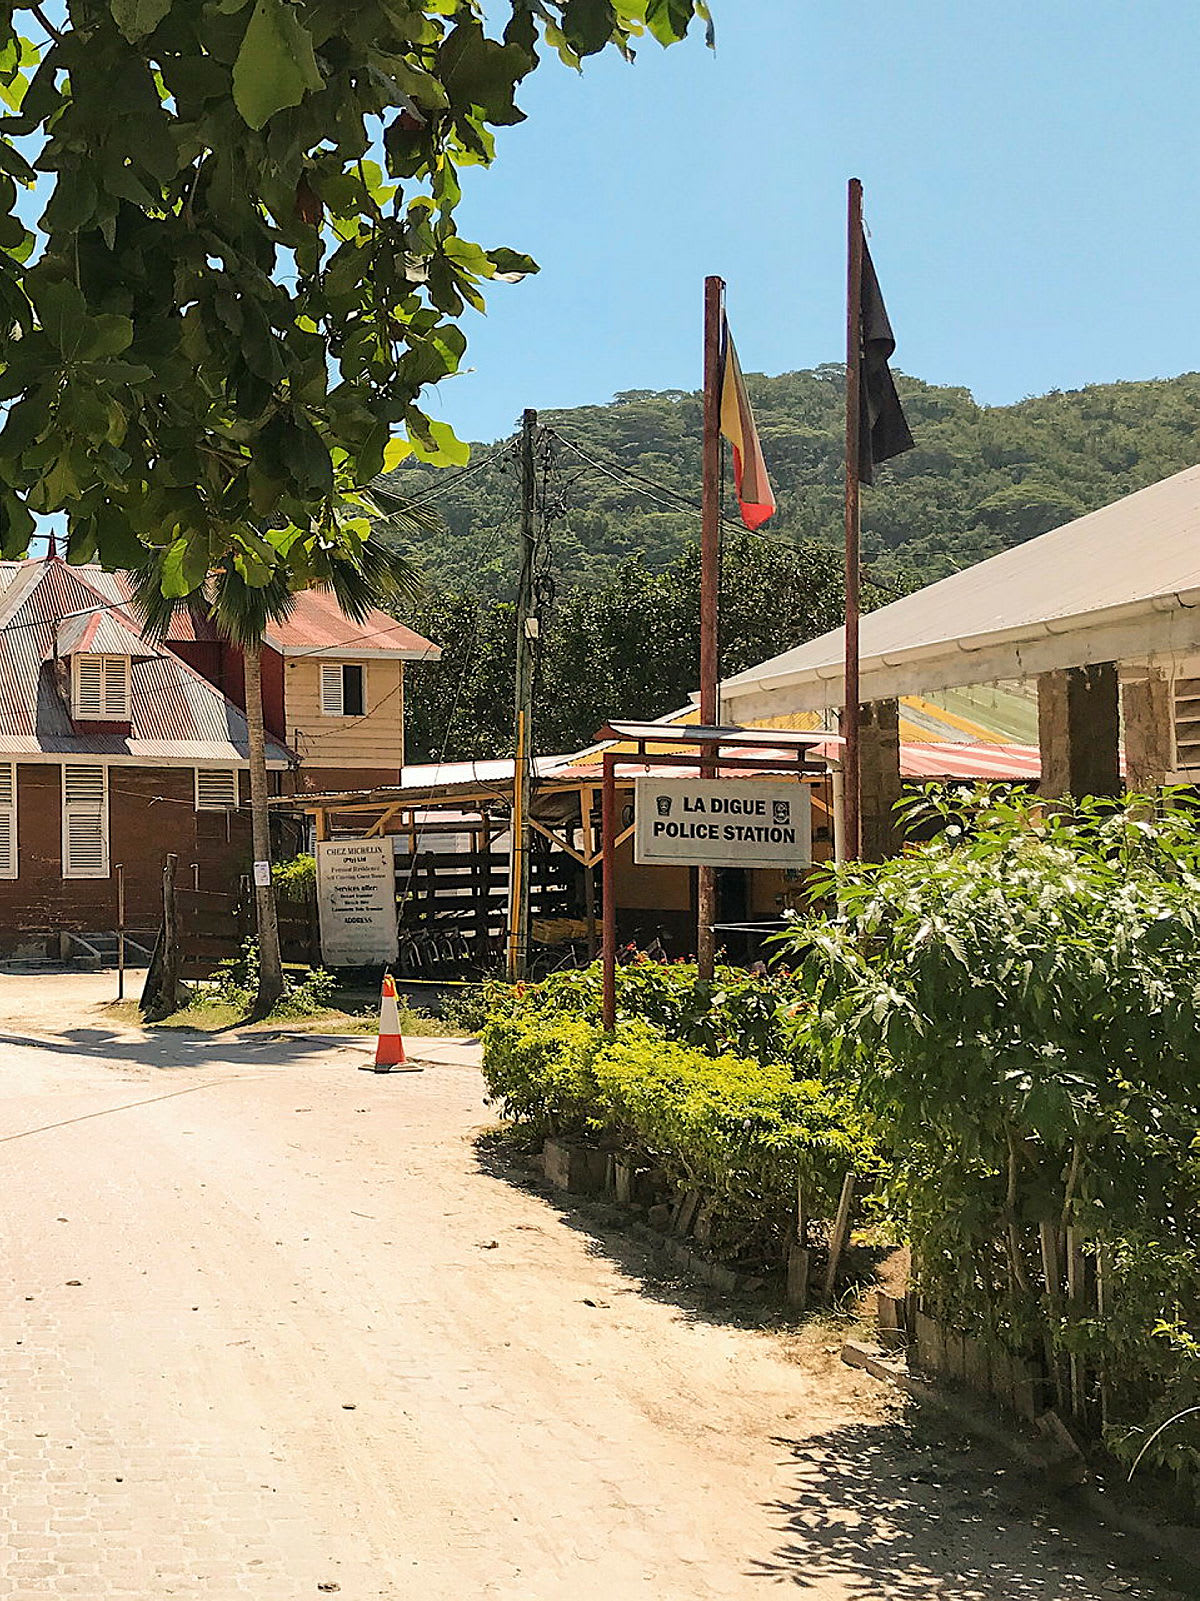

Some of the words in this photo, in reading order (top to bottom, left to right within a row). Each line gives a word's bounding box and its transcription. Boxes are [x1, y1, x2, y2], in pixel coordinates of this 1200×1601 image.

[683, 796, 706, 813] LA
[711, 798, 766, 815] DIGUE
[653, 821, 719, 840] POLICE
[723, 825, 796, 844] STATION
[326, 847, 347, 856] CHEZ
[347, 846, 383, 855] MICHELIN
